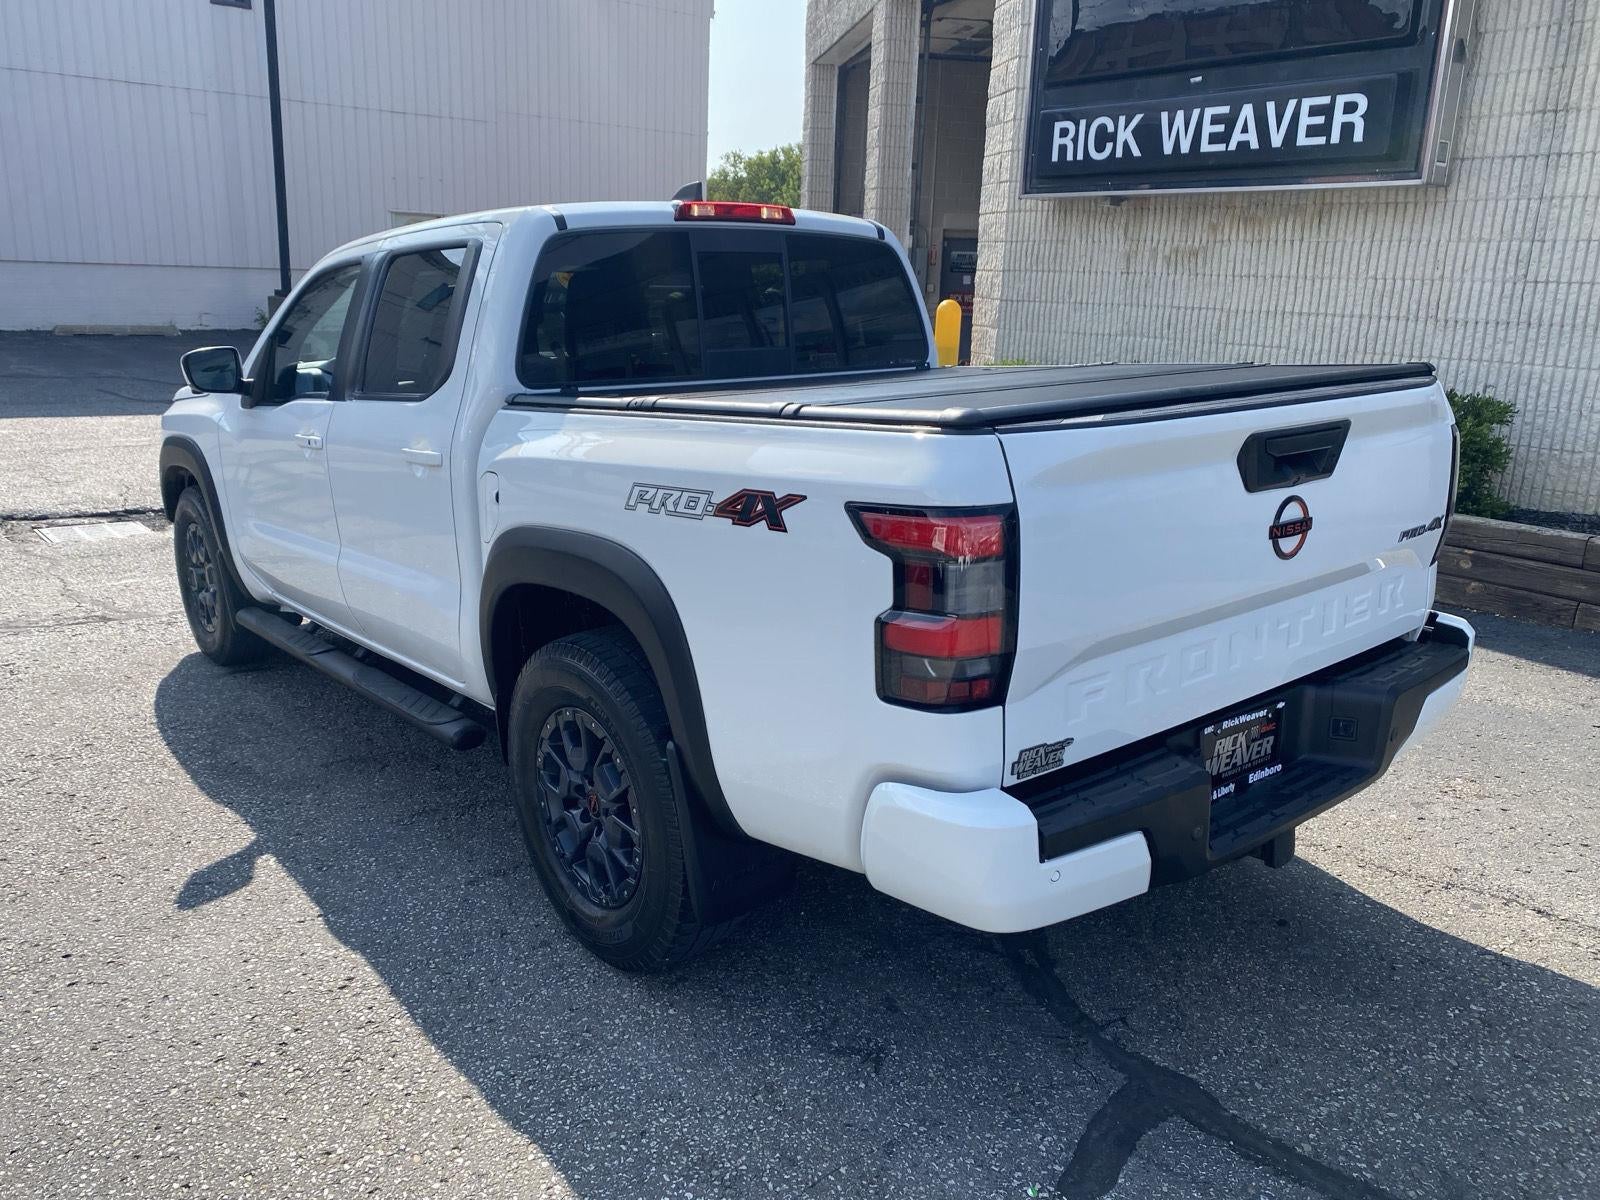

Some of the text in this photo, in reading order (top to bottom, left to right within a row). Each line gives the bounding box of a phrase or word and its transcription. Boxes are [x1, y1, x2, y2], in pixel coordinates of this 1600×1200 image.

[1051, 93, 1369, 162] RICK WEAVER
[624, 482, 808, 533] PRO-4X
[1272, 519, 1313, 537] NISSAN
[1065, 574, 1406, 727] FRONTIER
[1222, 709, 1268, 730] RickWeaver
[1021, 745, 1047, 762] RICK
[1213, 730, 1248, 757] RICK
[1013, 750, 1066, 774] WEAVER
[1205, 736, 1275, 776] WEAVER
[1248, 764, 1282, 784] Edinboro
[1217, 783, 1235, 798] Liberty
